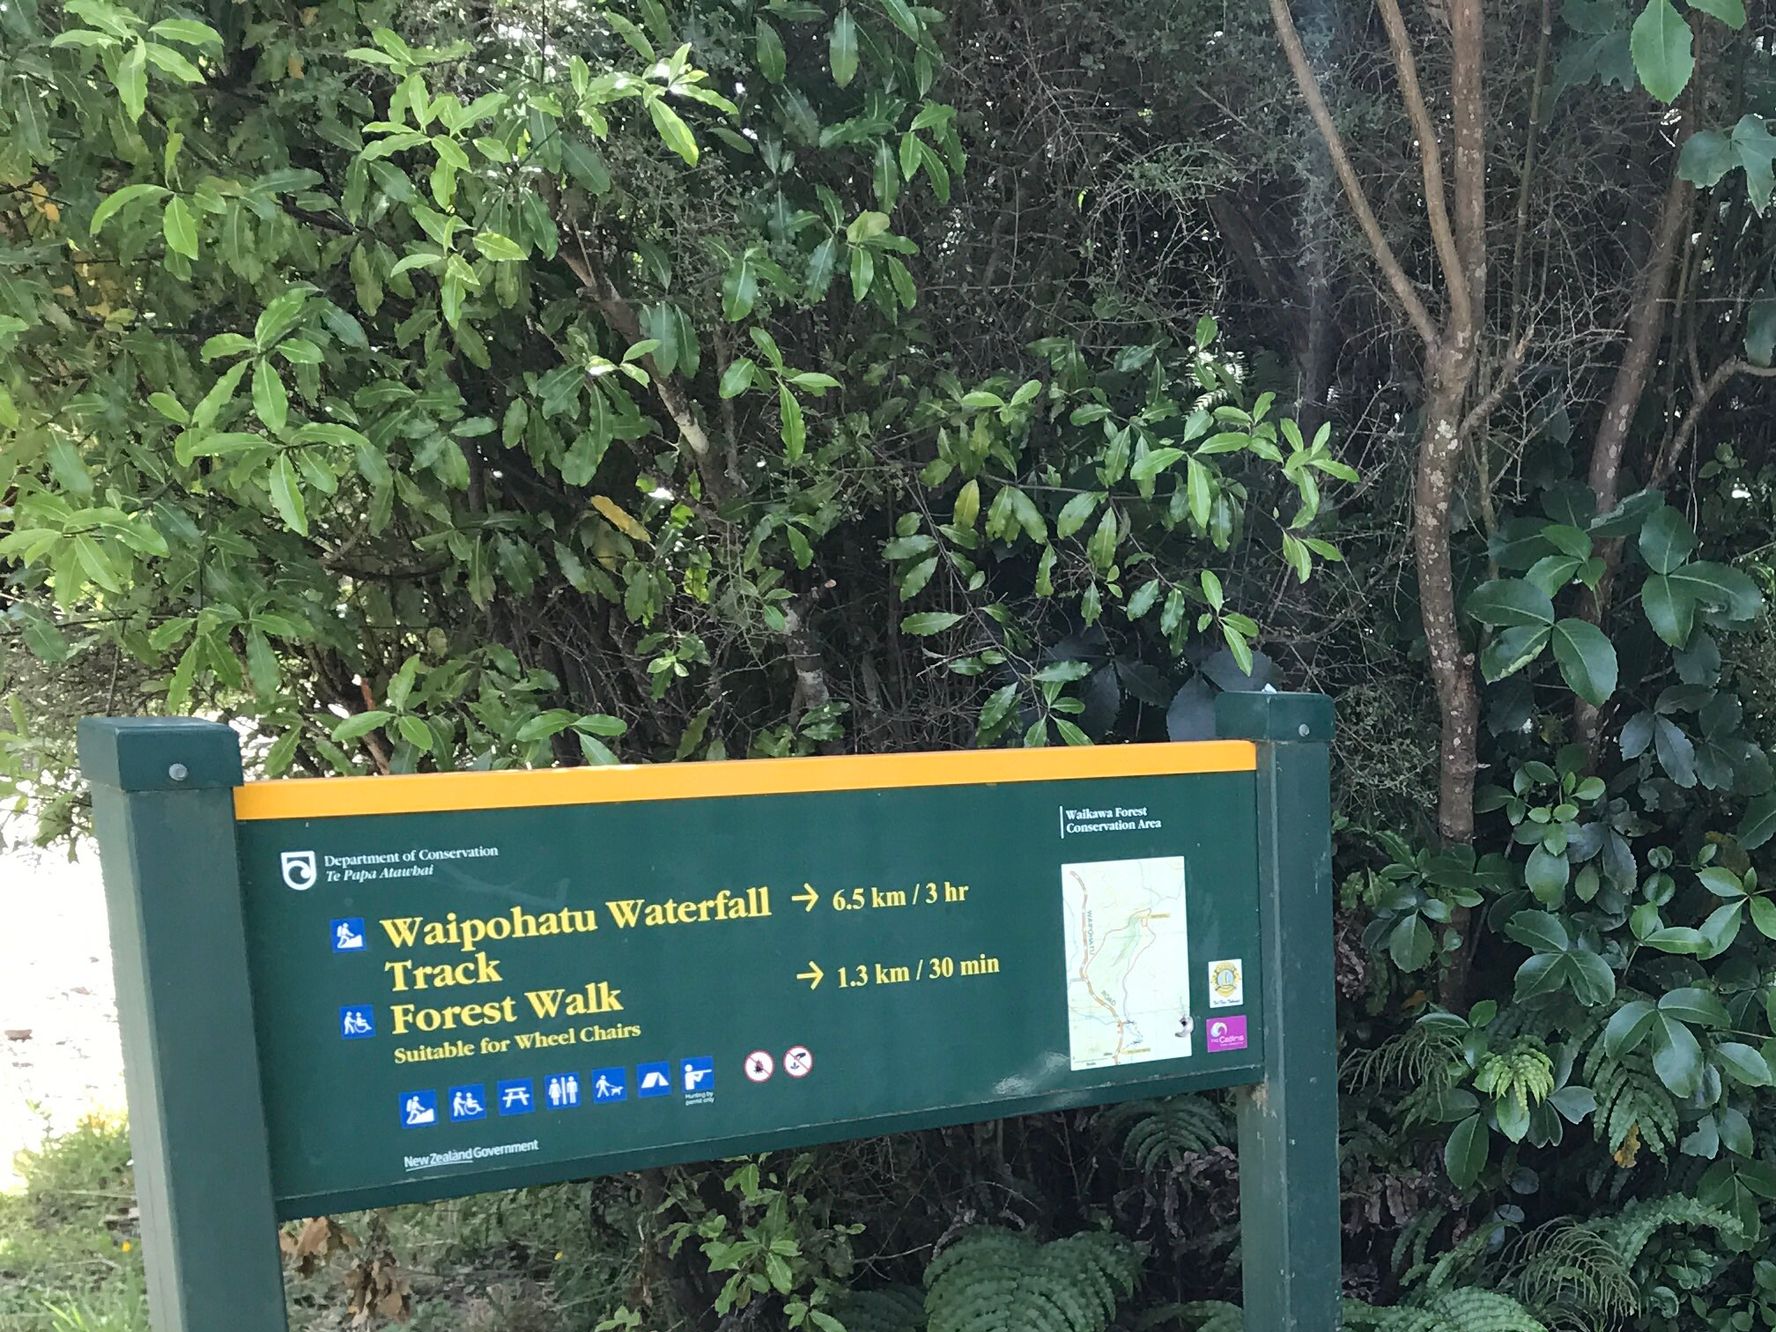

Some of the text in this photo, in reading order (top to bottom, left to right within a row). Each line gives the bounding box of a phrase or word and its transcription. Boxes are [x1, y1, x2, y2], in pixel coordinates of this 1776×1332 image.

[1066, 806, 1147, 820] Waikawa Forest
[1066, 819, 1162, 834] Conservation Area
[324, 845, 499, 869] Department of Conservation
[326, 864, 434, 884] Te Papa Atawhai
[832, 881, 969, 911] 6.5 km / 3 hr
[380, 886, 772, 951] Waipohatu Waterfall
[384, 952, 503, 992] Track
[837, 953, 1000, 988] 1.3 km / 30 min
[390, 981, 624, 1035] Forest Walk
[394, 1022, 641, 1064] Suitable for Wheel Chairs
[404, 1139, 539, 1168] New Zealand Government
